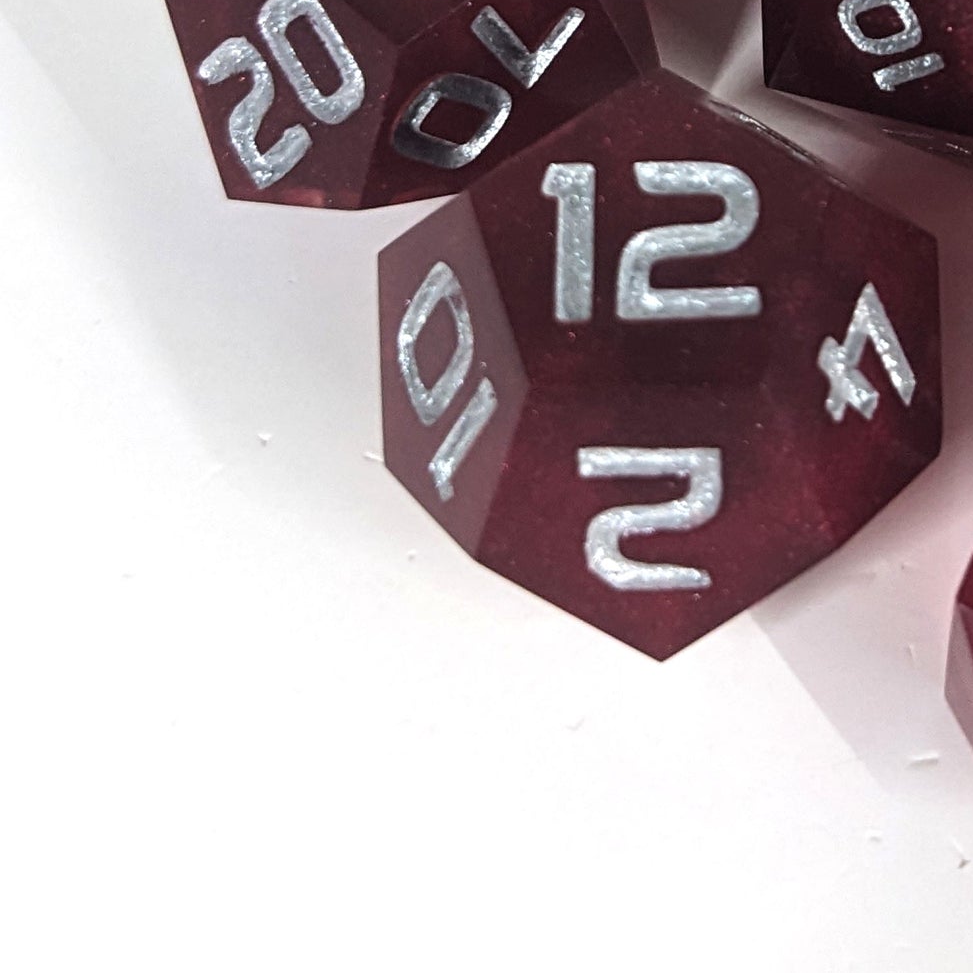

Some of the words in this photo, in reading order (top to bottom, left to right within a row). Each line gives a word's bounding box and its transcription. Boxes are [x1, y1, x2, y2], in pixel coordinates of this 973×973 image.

[392, 5, 585, 169] 70
[541, 161, 761, 323] 12
[397, 261, 498, 503] 10
[817, 281, 916, 422] 4
